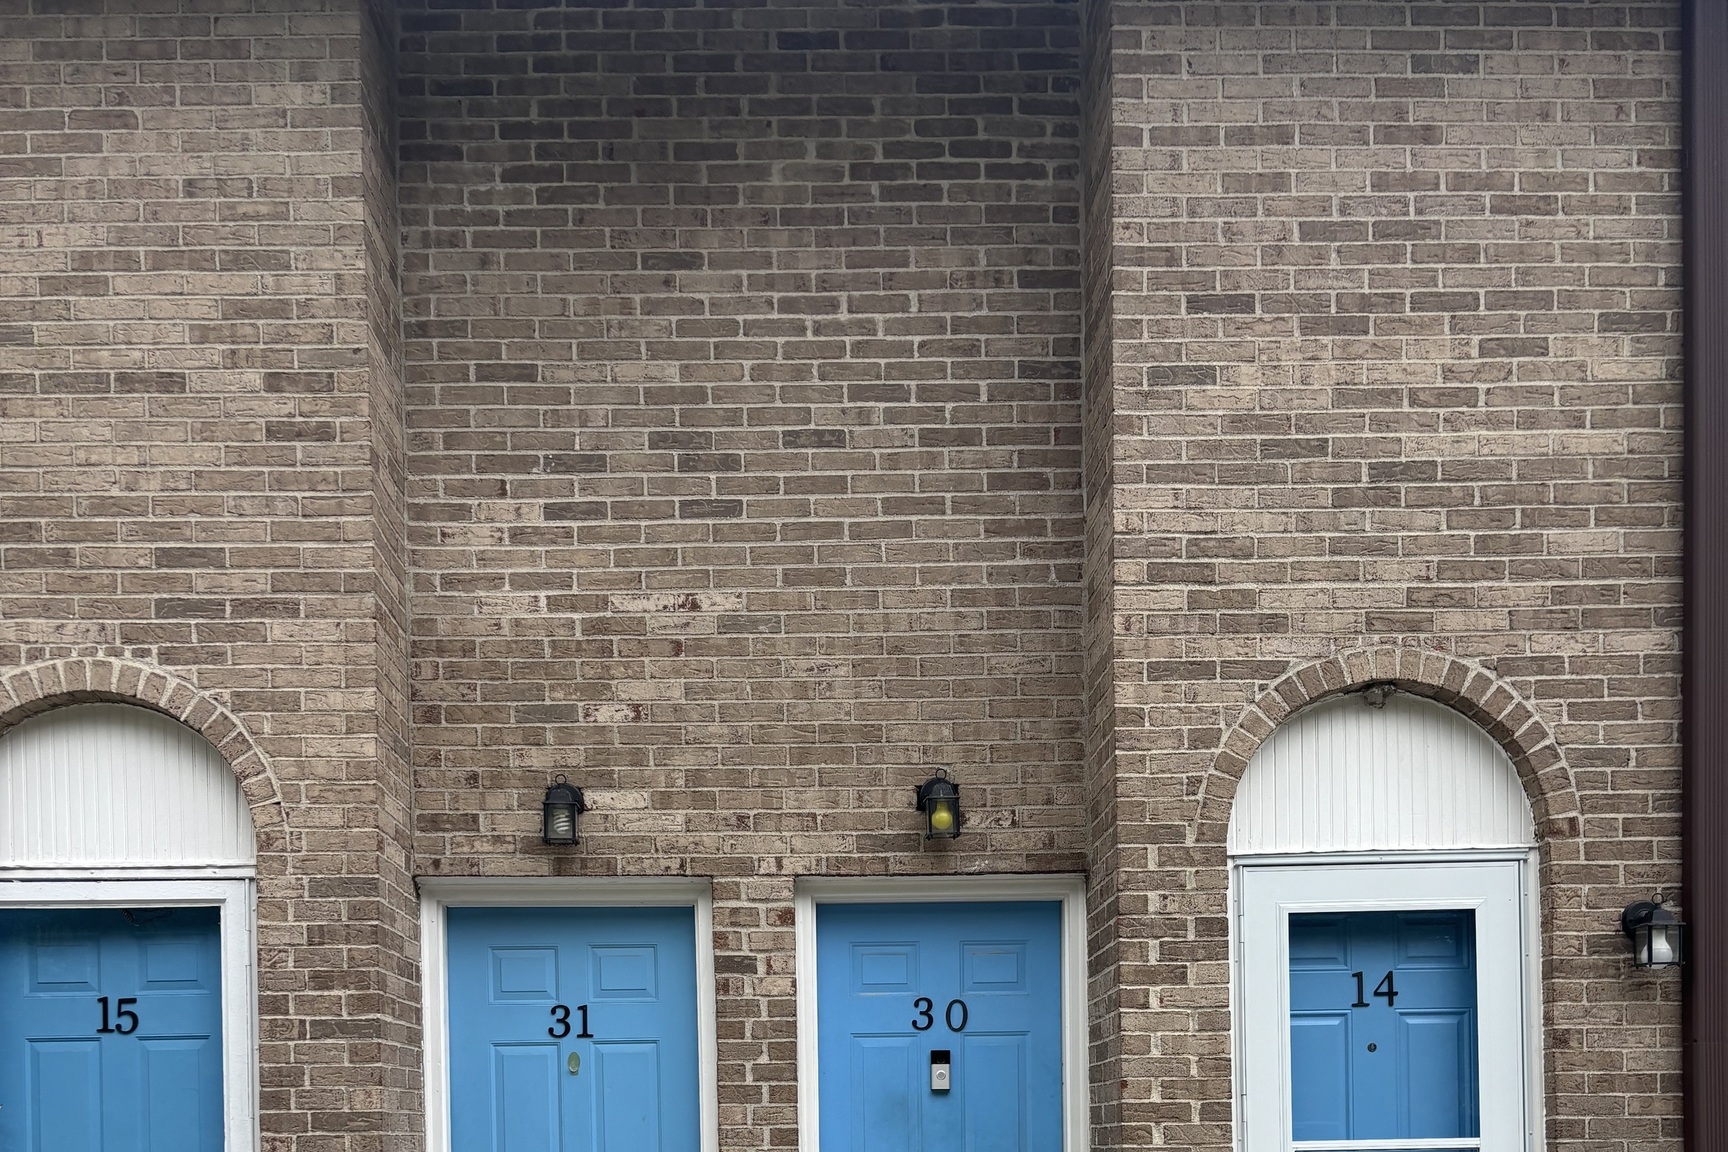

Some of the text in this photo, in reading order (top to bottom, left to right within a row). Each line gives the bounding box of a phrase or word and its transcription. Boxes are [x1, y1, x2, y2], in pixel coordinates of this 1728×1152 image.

[1351, 970, 1399, 1008] 14
[96, 996, 139, 1036] 15
[547, 1004, 594, 1039] 31
